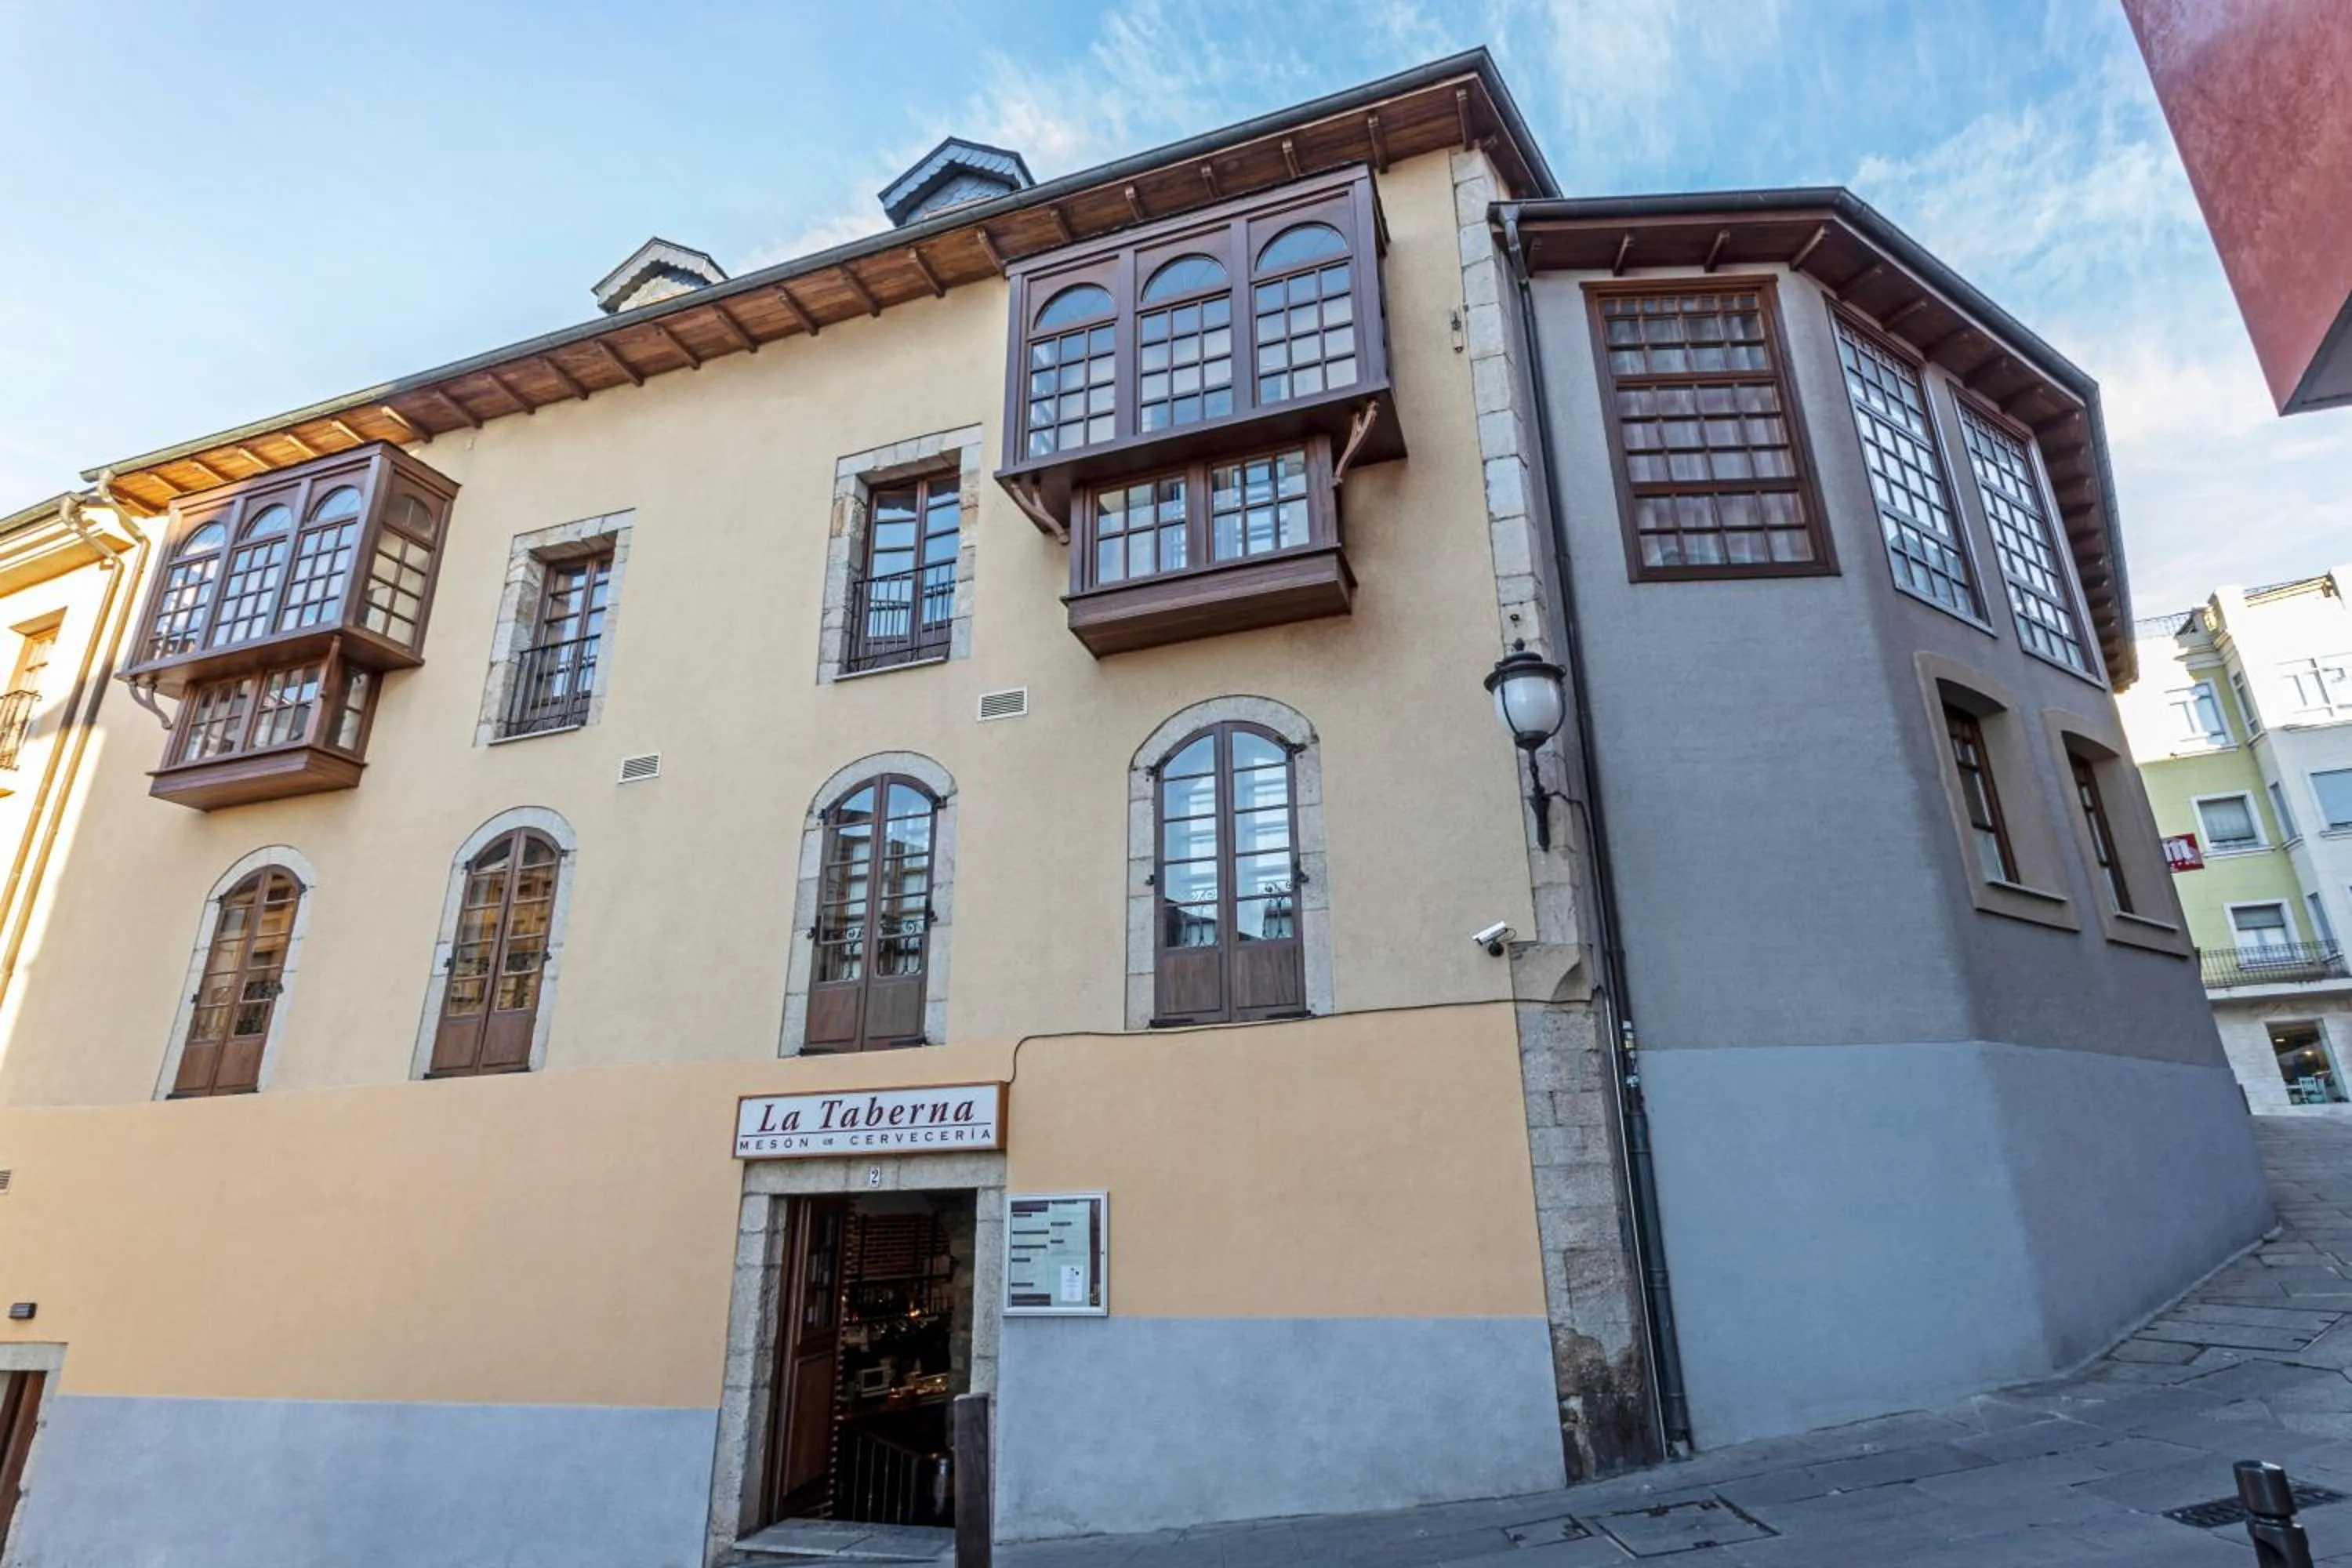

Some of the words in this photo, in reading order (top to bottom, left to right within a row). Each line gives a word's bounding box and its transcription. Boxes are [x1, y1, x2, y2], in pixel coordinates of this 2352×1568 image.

[757, 1103, 800, 1132] La
[819, 1096, 975, 1130] Taberna
[739, 1137, 808, 1150] MESÓN
[850, 1127, 991, 1145] CERVECERÍA
[871, 1168, 879, 1183] 2
